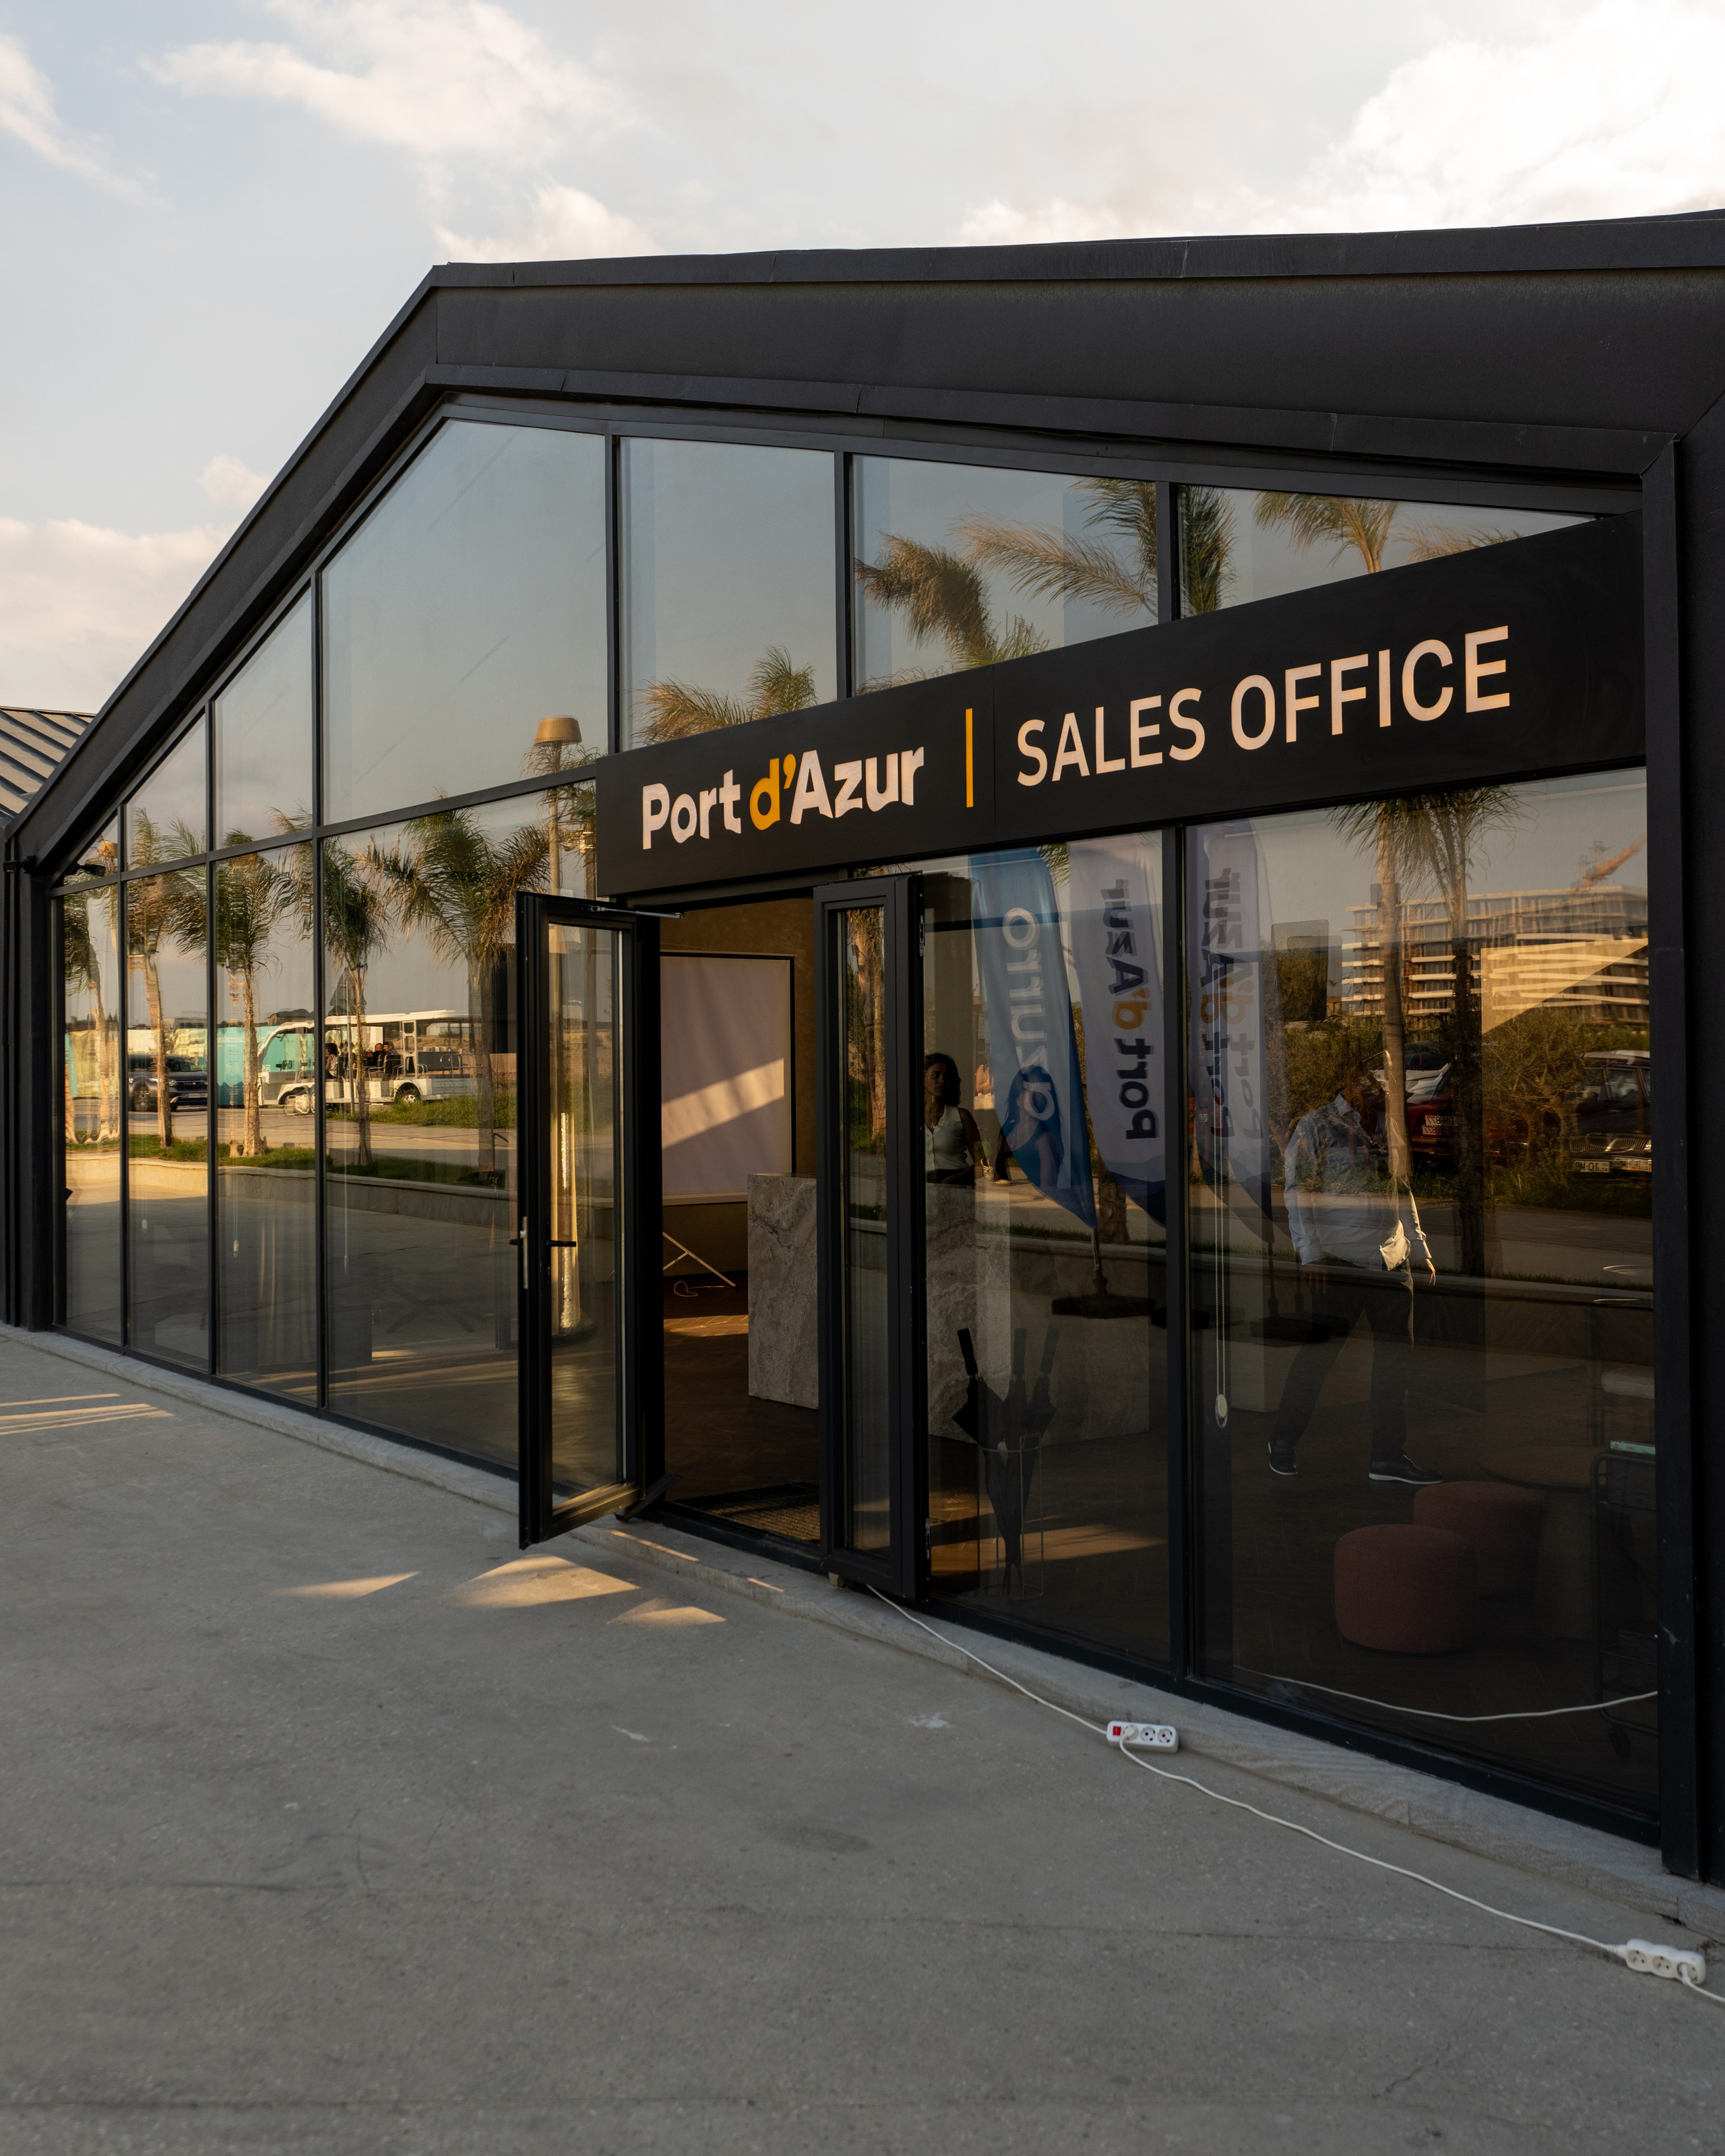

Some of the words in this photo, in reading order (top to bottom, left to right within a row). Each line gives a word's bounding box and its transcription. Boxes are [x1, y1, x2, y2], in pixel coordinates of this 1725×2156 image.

[642, 769, 741, 850] Port
[749, 746, 924, 830] d'Azur
[1017, 687, 1205, 787] SALES
[1230, 625, 1511, 751] OFFICE
